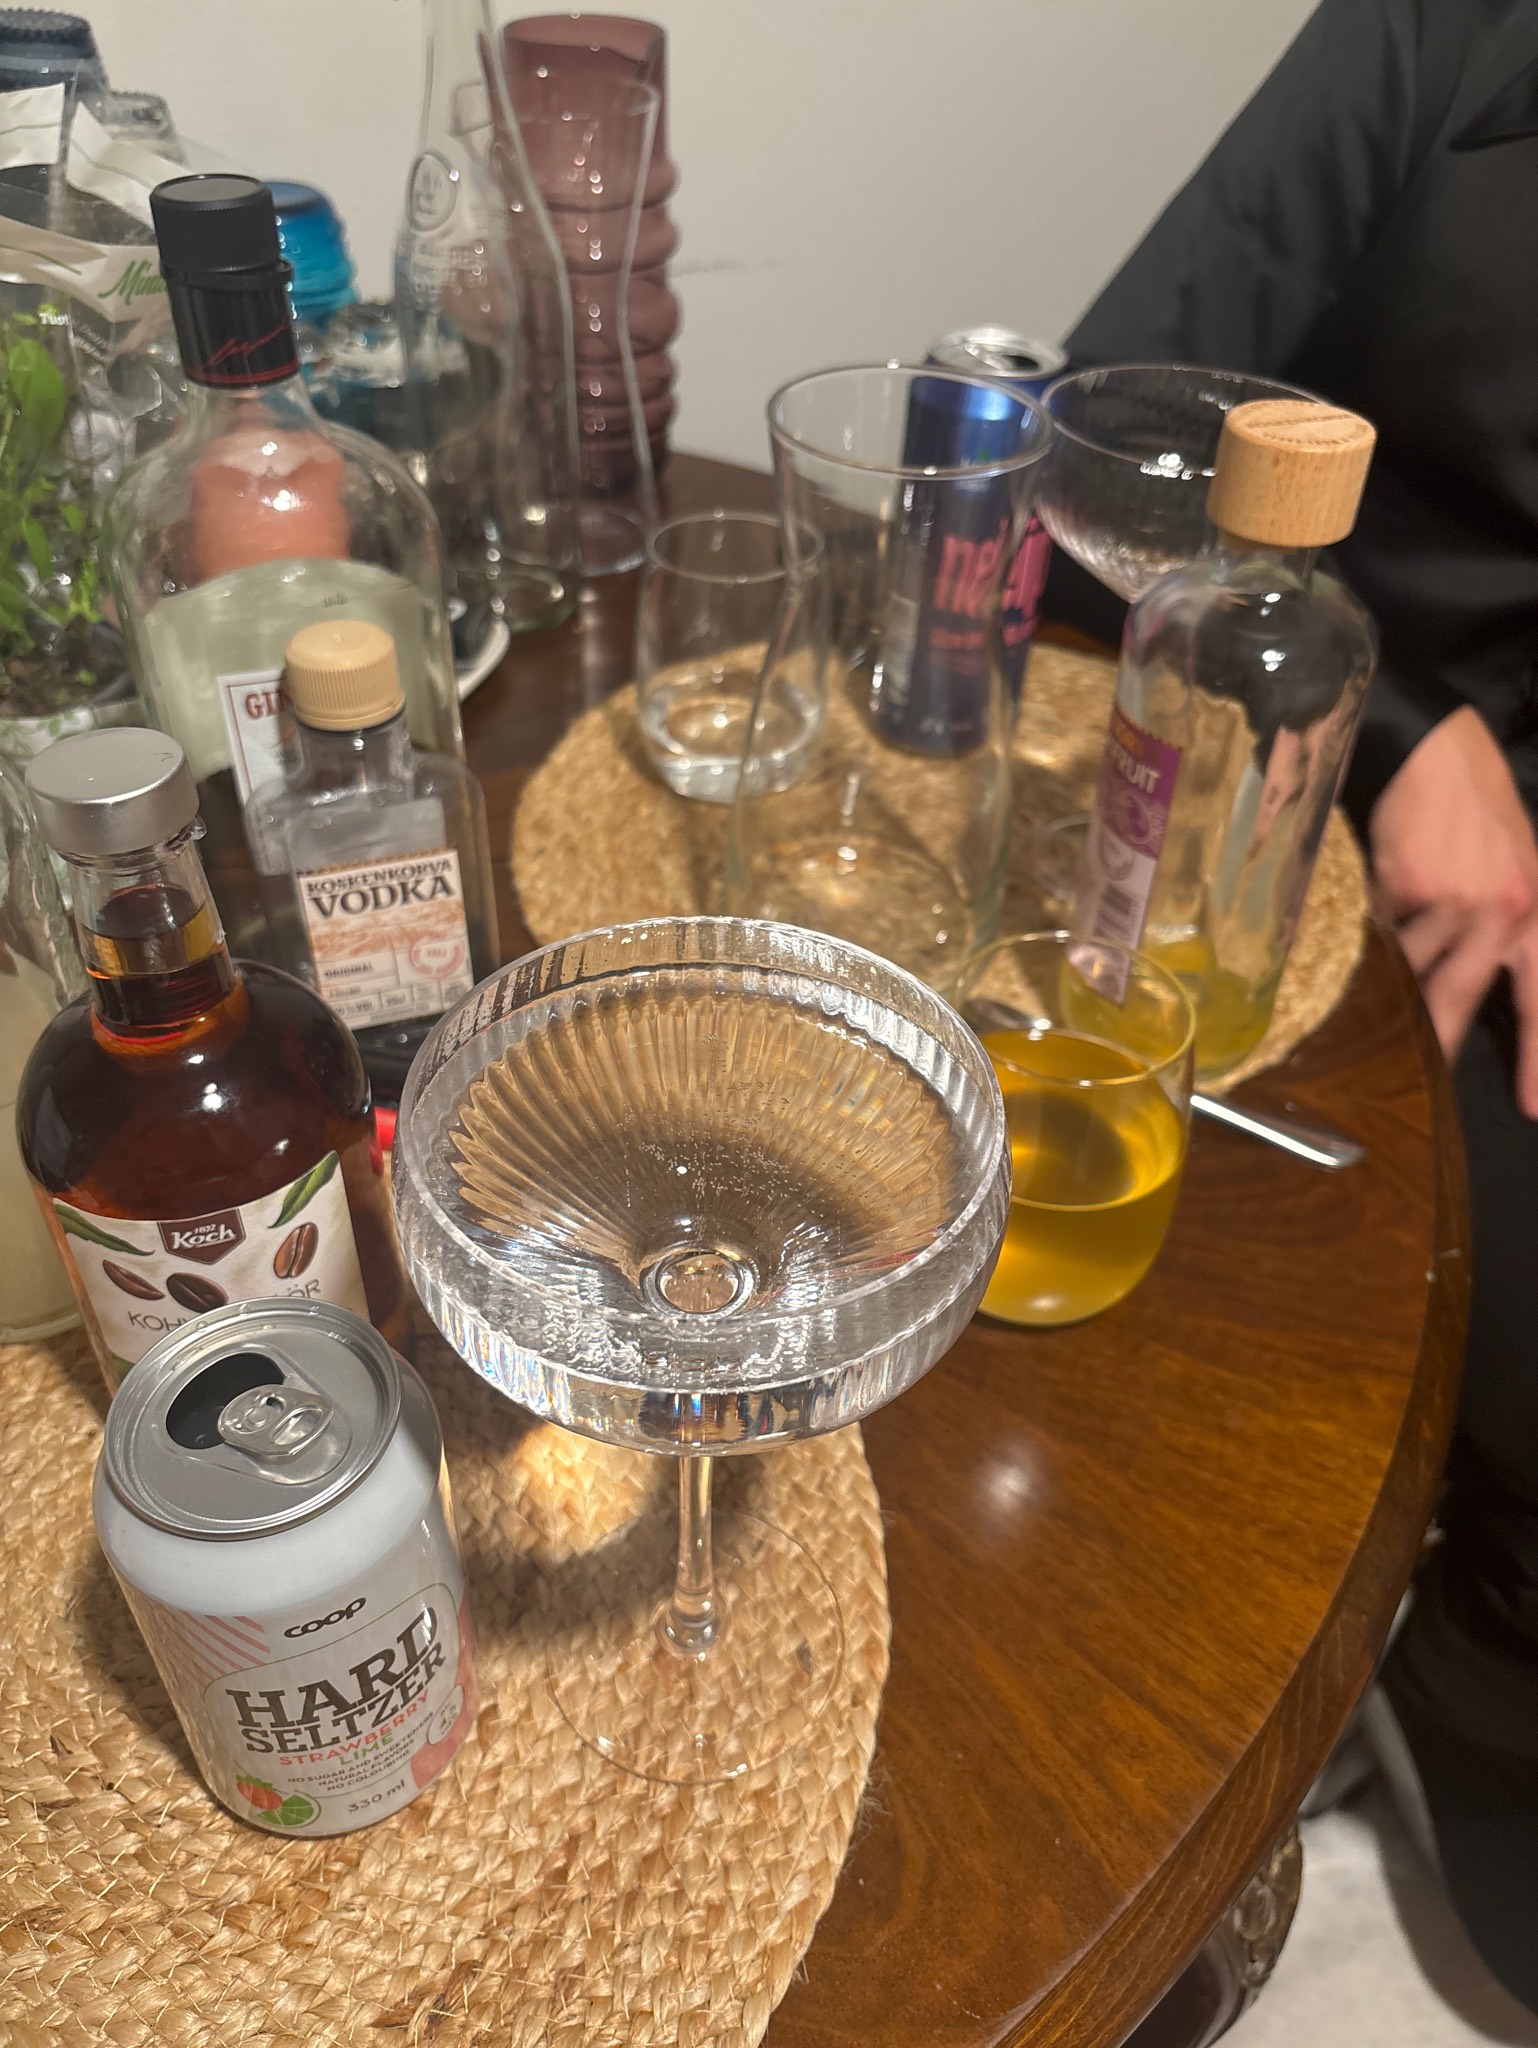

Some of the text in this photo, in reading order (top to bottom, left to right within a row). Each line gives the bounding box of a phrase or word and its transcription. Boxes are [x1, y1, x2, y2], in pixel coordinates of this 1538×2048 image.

[311, 875, 456, 918] VODKA
[171, 1224, 236, 1250] Koch
[194, 1224, 217, 1235] 1872
[284, 1597, 366, 1638] coop
[225, 1607, 437, 1728] HARD
[241, 1642, 446, 1754] SELTZER
[279, 1689, 429, 1767] STRAWBERRY
[287, 1711, 434, 1784] NO SUGAR AND SWEETENERS
[339, 1734, 395, 1765] LIME
[318, 1769, 370, 1786] NATURAL
[327, 1750, 410, 1791] NO COLOURING
[348, 1780, 405, 1812] 330 ml
